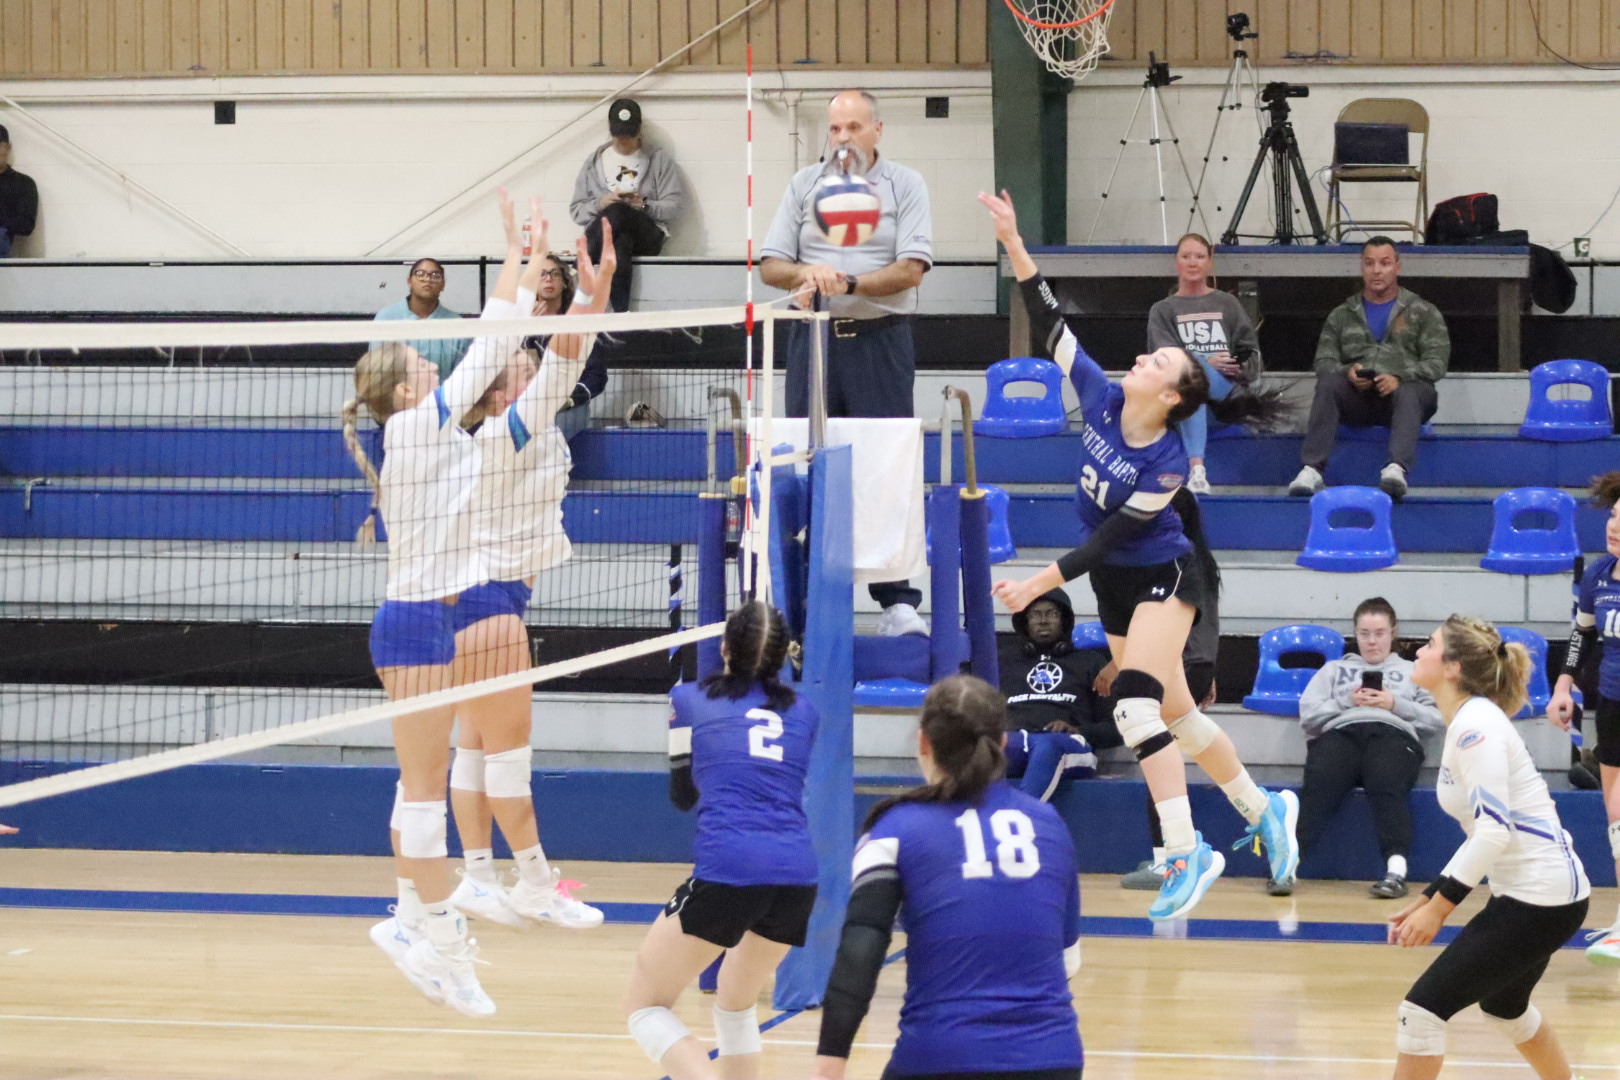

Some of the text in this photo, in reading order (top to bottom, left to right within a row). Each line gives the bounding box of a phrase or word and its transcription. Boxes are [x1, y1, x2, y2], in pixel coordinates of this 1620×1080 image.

[1177, 321, 1228, 344] USA
[1080, 464, 1110, 511] 21
[744, 707, 784, 762] 2
[955, 808, 1041, 879] 18
